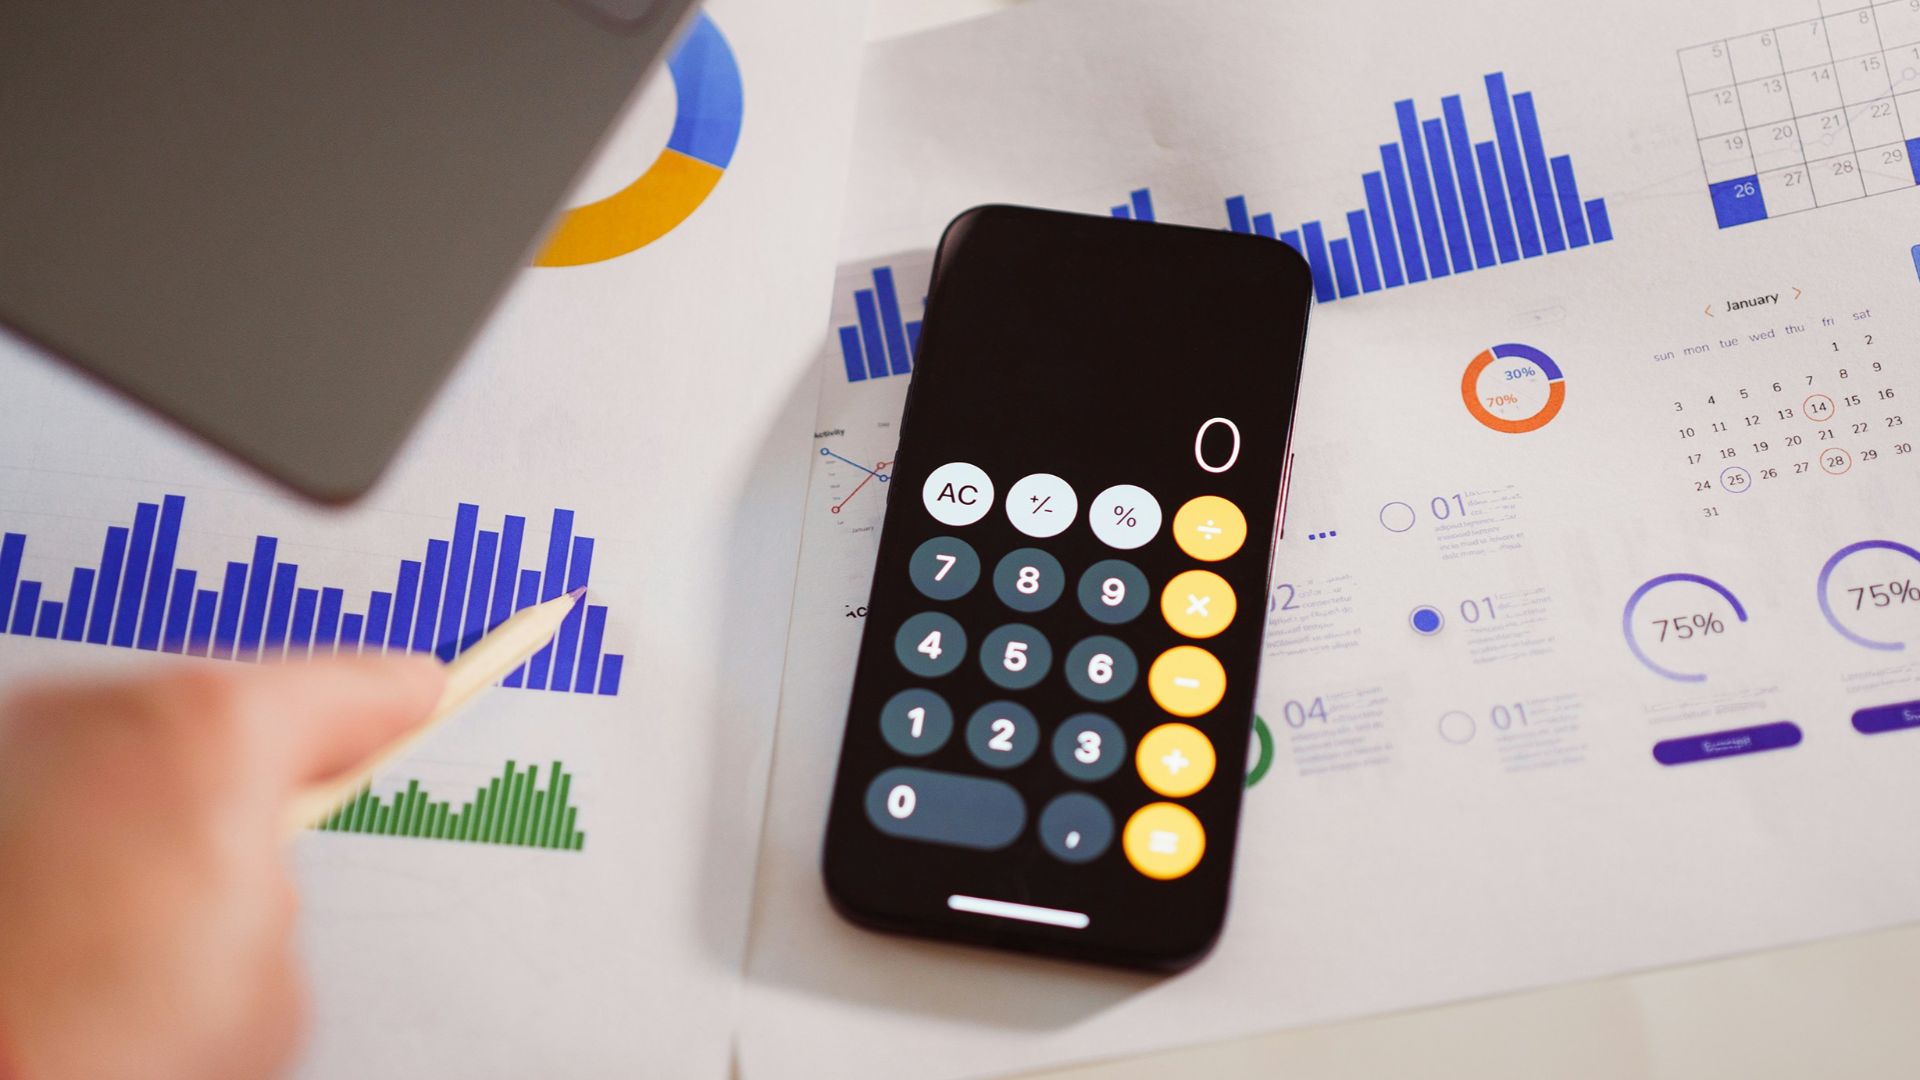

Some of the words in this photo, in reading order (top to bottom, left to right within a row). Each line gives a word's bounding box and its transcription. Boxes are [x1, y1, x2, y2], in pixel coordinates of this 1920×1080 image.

[1712, 45, 1722, 58] 5
[1761, 34, 1771, 46] 6
[1811, 22, 1818, 35] 7
[1859, 11, 1869, 24] 8
[1910, 0, 1920, 12] 9
[1715, 90, 1732, 104] 12
[1763, 80, 1782, 93] 13
[1812, 69, 1829, 82] 14
[1861, 57, 1880, 71] 15
[1725, 136, 1743, 150] 19
[1773, 126, 1792, 140] 20
[1821, 115, 1840, 129] 21
[1871, 103, 1891, 118] 22
[1734, 182, 1755, 198] 26
[1785, 172, 1802, 186] 27
[1833, 160, 1853, 175] 28
[1882, 149, 1902, 164] 29
[1727, 293, 1779, 311] January
[1654, 351, 1674, 362] sun
[1684, 344, 1709, 355] mon
[1720, 338, 1738, 348] tue
[1749, 329, 1775, 342] wed
[1785, 324, 1804, 334] thu
[1822, 318, 1834, 326] fri
[1853, 309, 1871, 320] sat
[1832, 342, 1839, 351] 1
[1865, 335, 1873, 344] 2
[1505, 367, 1535, 380] 30%
[1675, 402, 1682, 411] 3
[1708, 396, 1715, 405] 4
[1740, 389, 1748, 399] 5
[1773, 383, 1781, 392] 6
[1806, 376, 1813, 385] 7
[1840, 369, 1848, 378] 8
[1873, 362, 1881, 372] 9
[1486, 394, 1518, 407] 70%
[1680, 428, 1695, 439] 10
[1712, 422, 1727, 432] 11
[1745, 416, 1760, 426] 12
[1778, 409, 1793, 420] 13
[1812, 402, 1826, 413] 14
[1845, 395, 1860, 406] 15
[1879, 389, 1894, 399] 16
[1195, 418, 1240, 473] 0
[1688, 454, 1701, 464] 17
[1720, 448, 1736, 458] 18
[1753, 442, 1768, 452] 19
[1785, 436, 1801, 446] 20
[1819, 430, 1833, 440] 21
[1852, 423, 1867, 434] 22
[1886, 416, 1902, 427] 23
[1695, 481, 1711, 491] 24
[1728, 474, 1744, 485] 25
[1761, 469, 1777, 479] 26
[1794, 462, 1808, 473] 27
[1827, 456, 1844, 467] 28
[1861, 450, 1877, 461] 29
[1894, 443, 1911, 454] 30
[937, 483, 978, 505] AC
[1114, 506, 1136, 527] %
[1431, 494, 1466, 520] 01
[1704, 507, 1719, 517] 31
[935, 555, 956, 581] 7
[1017, 567, 1039, 593] 8
[1102, 578, 1125, 606] 9
[1460, 597, 1496, 623] 01
[1652, 612, 1724, 642] 75%
[918, 631, 942, 659] 4
[1004, 642, 1027, 671] 5
[1088, 654, 1113, 683] 6
[908, 708, 924, 737] 1
[989, 719, 1015, 751] 2
[1075, 731, 1101, 763] 3
[1283, 697, 1327, 728] 04
[1491, 703, 1527, 730] 01
[888, 785, 916, 818] 0
